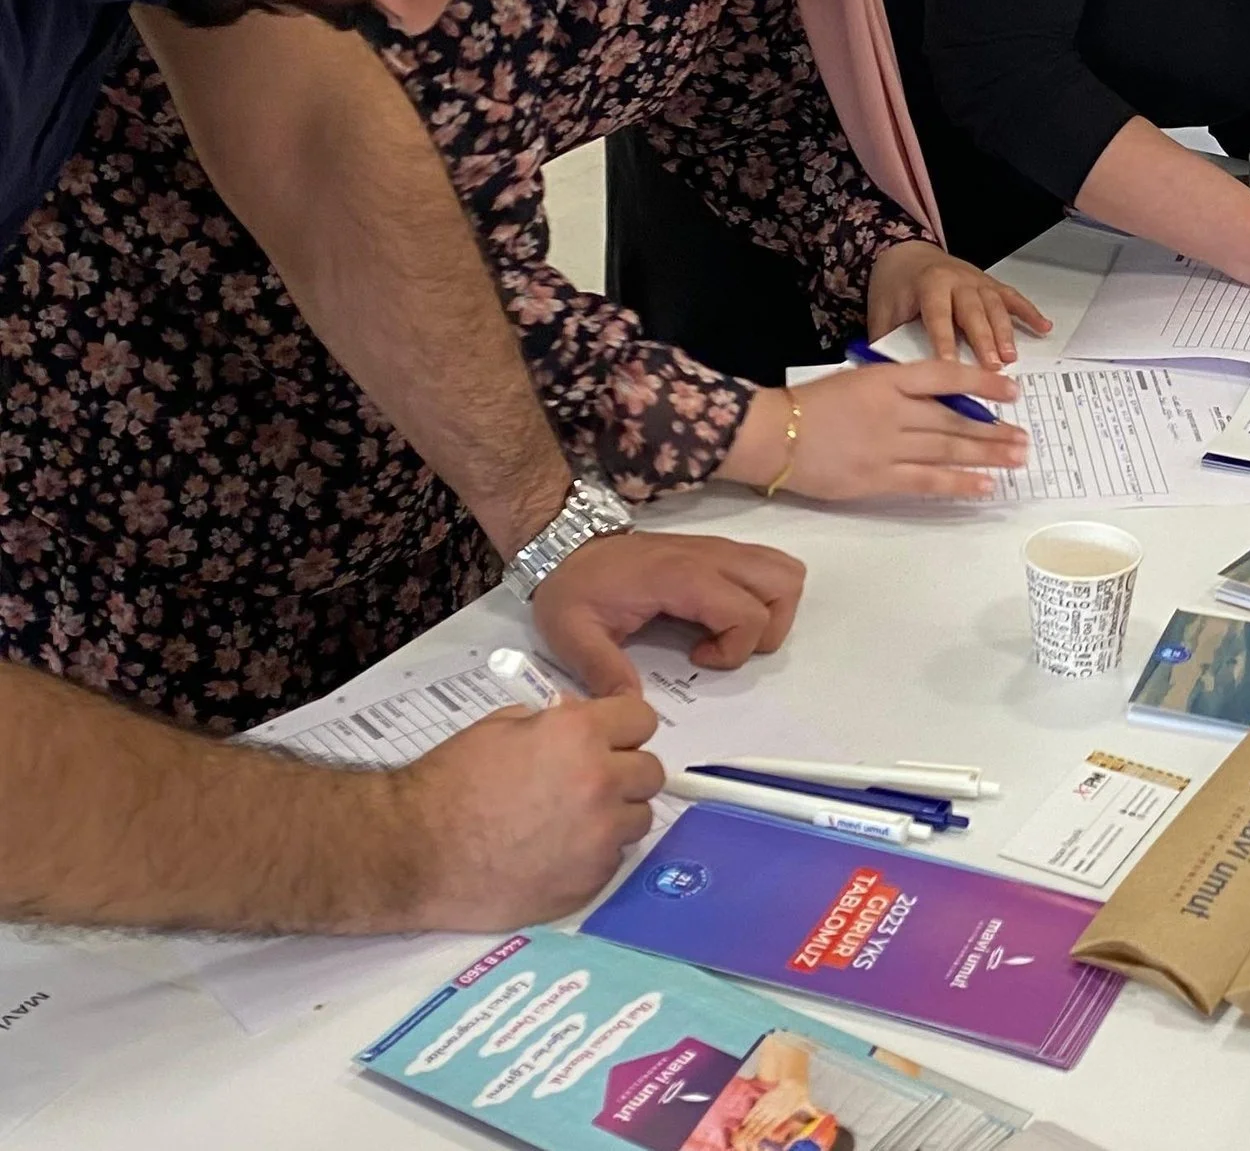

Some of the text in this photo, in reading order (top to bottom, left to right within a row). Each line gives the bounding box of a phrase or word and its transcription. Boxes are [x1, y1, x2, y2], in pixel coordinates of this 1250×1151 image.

[794, 873, 878, 968] TABLOMUZ
[1180, 860, 1239, 921] umut
[832, 895, 887, 958] GURUR
[852, 892, 918, 971] 2023 YKS
[976, 918, 1003, 954] mavi
[949, 952, 979, 989] umut
[613, 1049, 698, 1123] mavi umut
